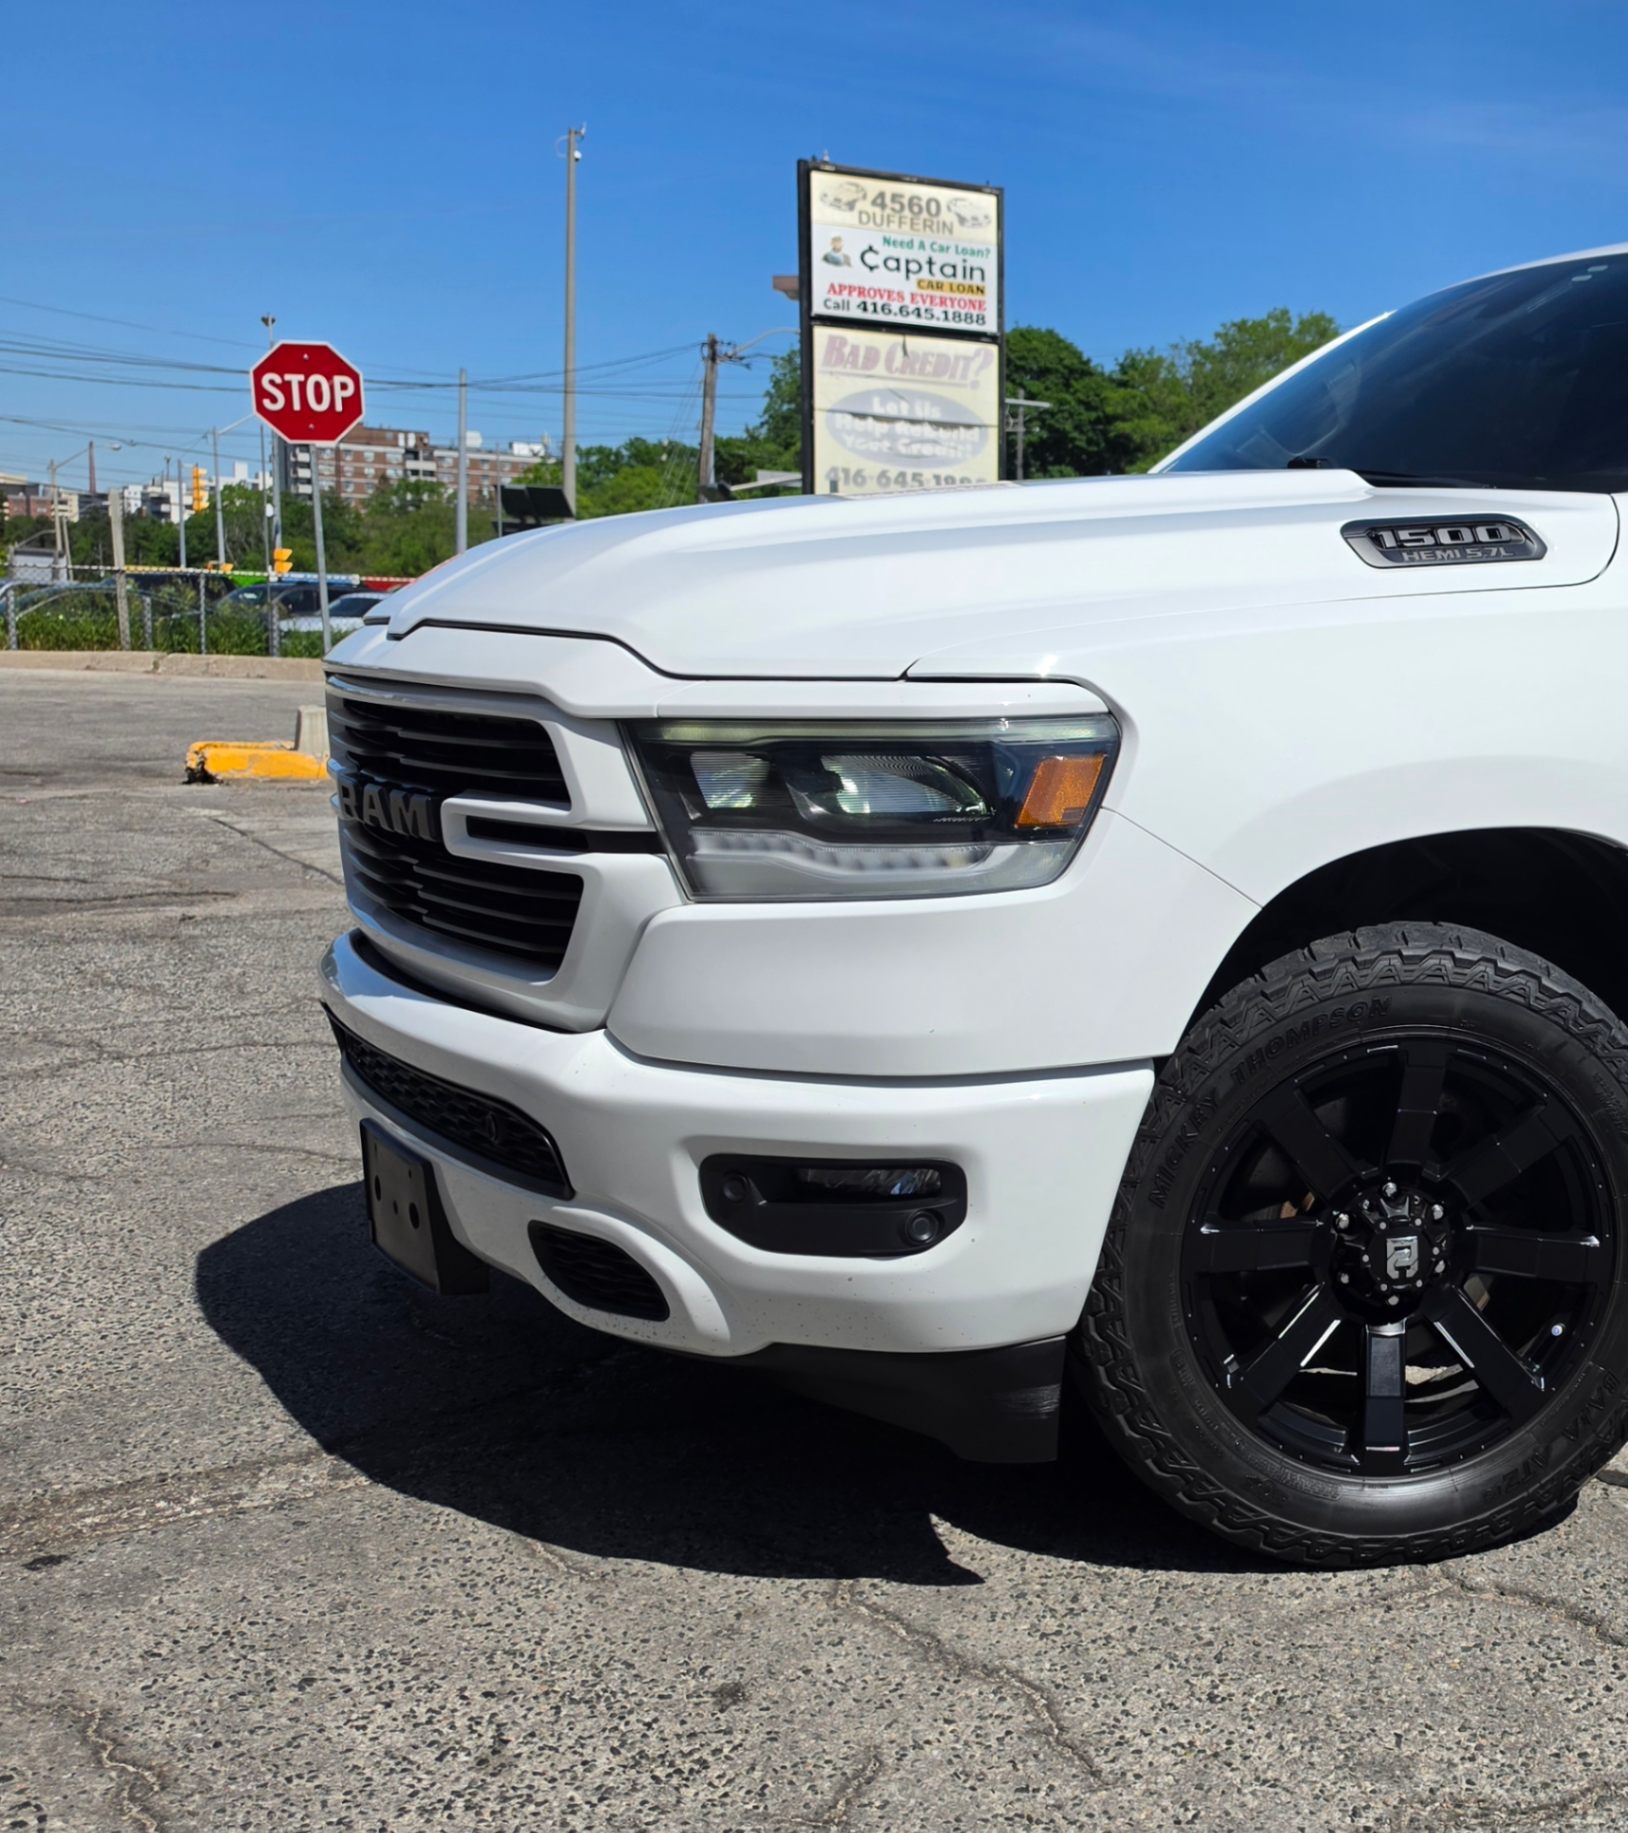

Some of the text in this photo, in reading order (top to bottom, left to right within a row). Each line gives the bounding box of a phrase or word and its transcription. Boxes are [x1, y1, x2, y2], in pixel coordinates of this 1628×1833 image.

[871, 191, 941, 217] 4560
[858, 211, 954, 235] DUFFERIN
[883, 236, 991, 258] Need A Car Loan?
[827, 282, 987, 311] APPROVES EVERYONE
[917, 279, 985, 295] CAR LOAN
[824, 298, 986, 325] Call 416.645.1888
[261, 372, 355, 412] STOP
[873, 396, 942, 419] Let Us
[1377, 524, 1511, 548] 1500
[1402, 547, 1514, 562] HEMI 5.7L
[338, 773, 438, 842] RAM
[1231, 996, 1393, 1086] THOMPSON
